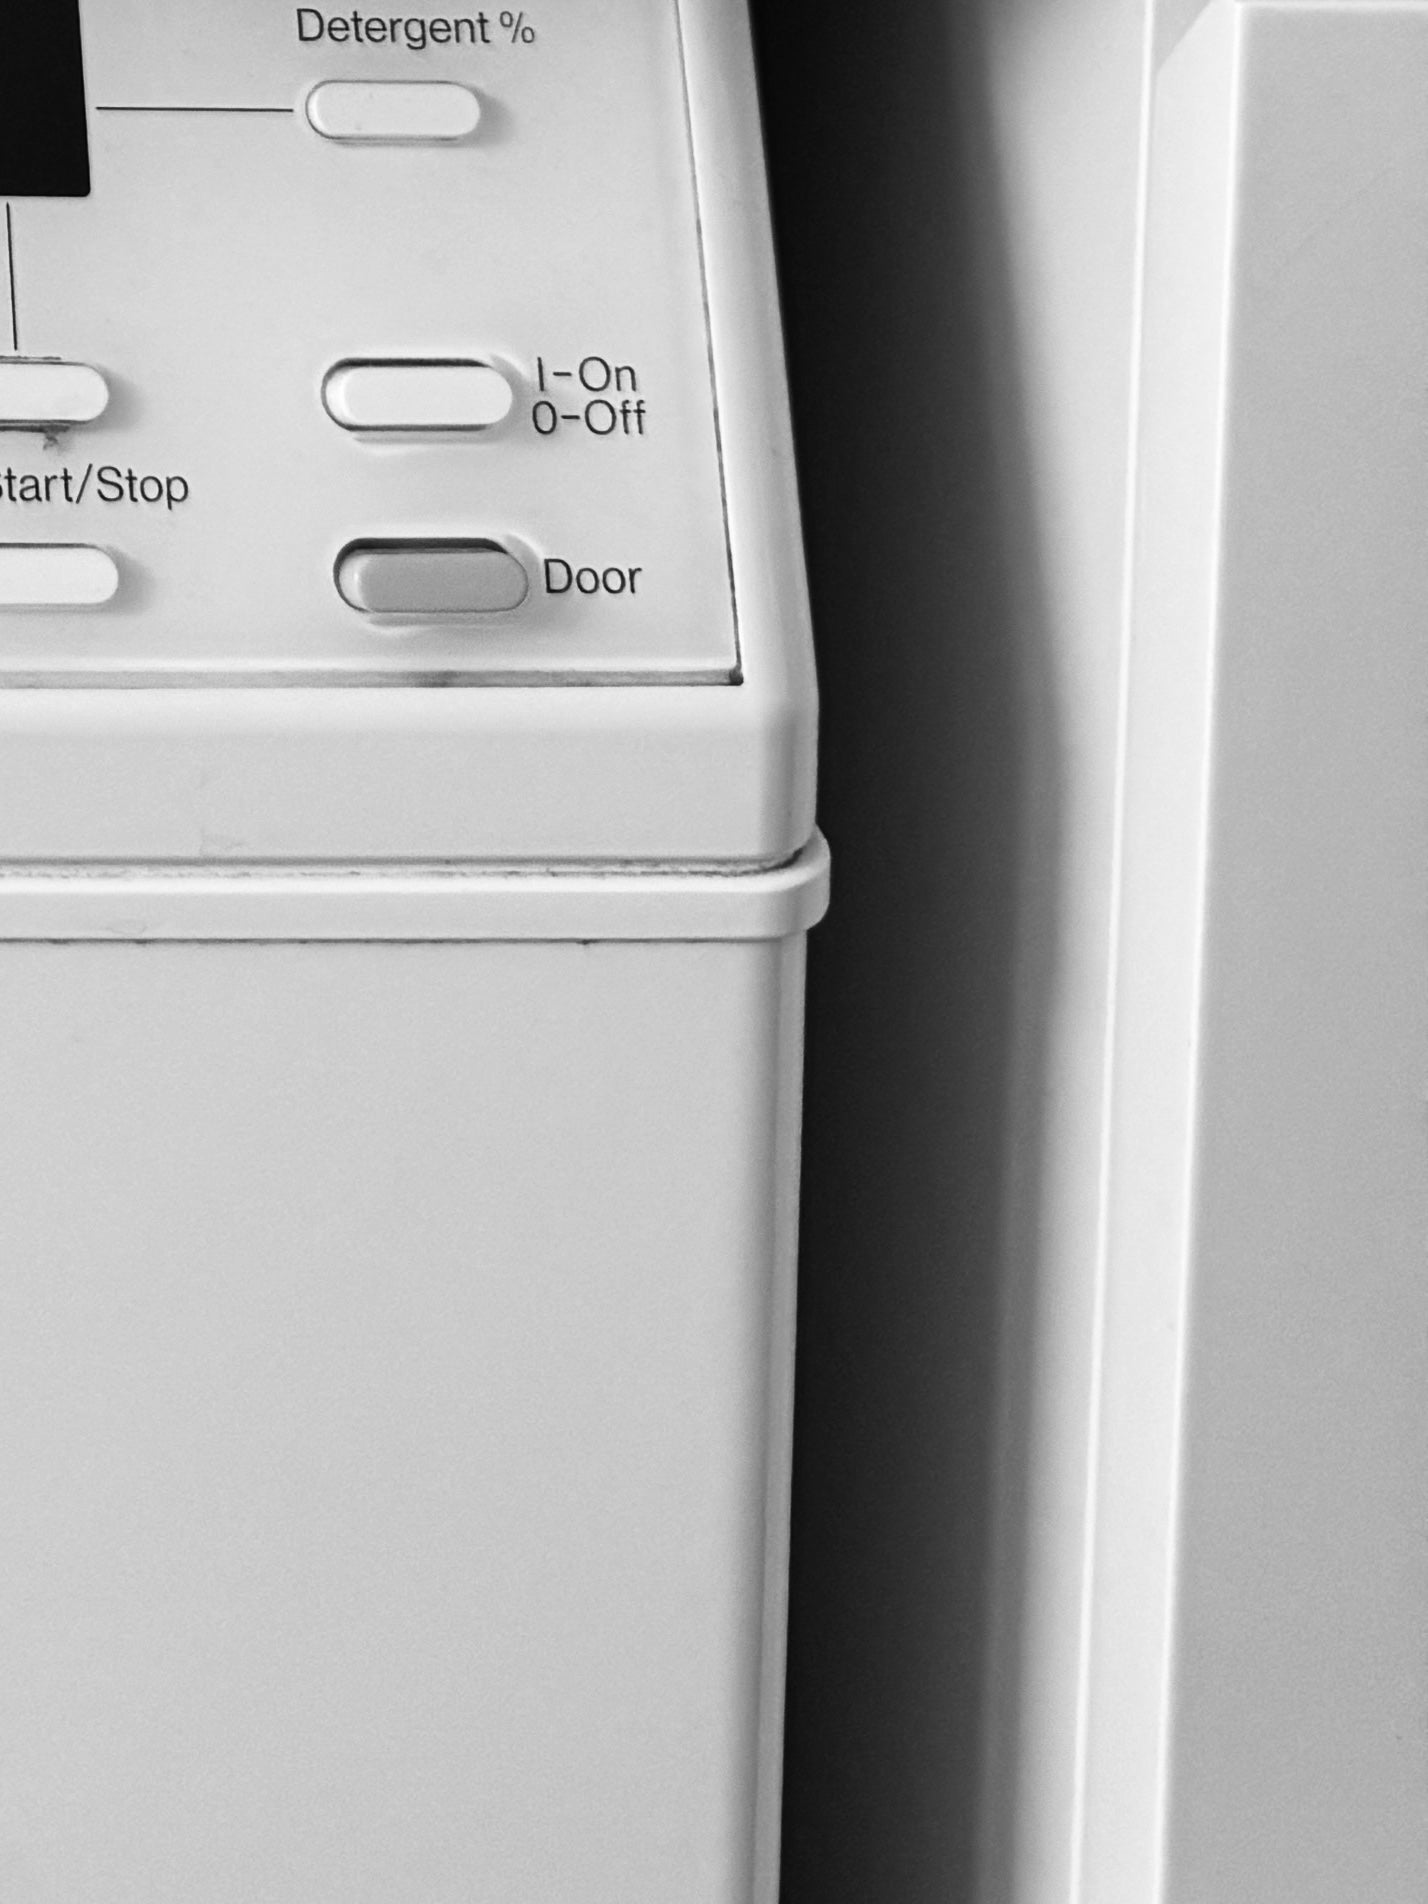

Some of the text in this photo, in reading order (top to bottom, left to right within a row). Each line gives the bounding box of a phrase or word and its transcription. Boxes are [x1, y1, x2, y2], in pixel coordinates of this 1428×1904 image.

[296, 8, 536, 51] Detergent %
[543, 558, 643, 595] Door
